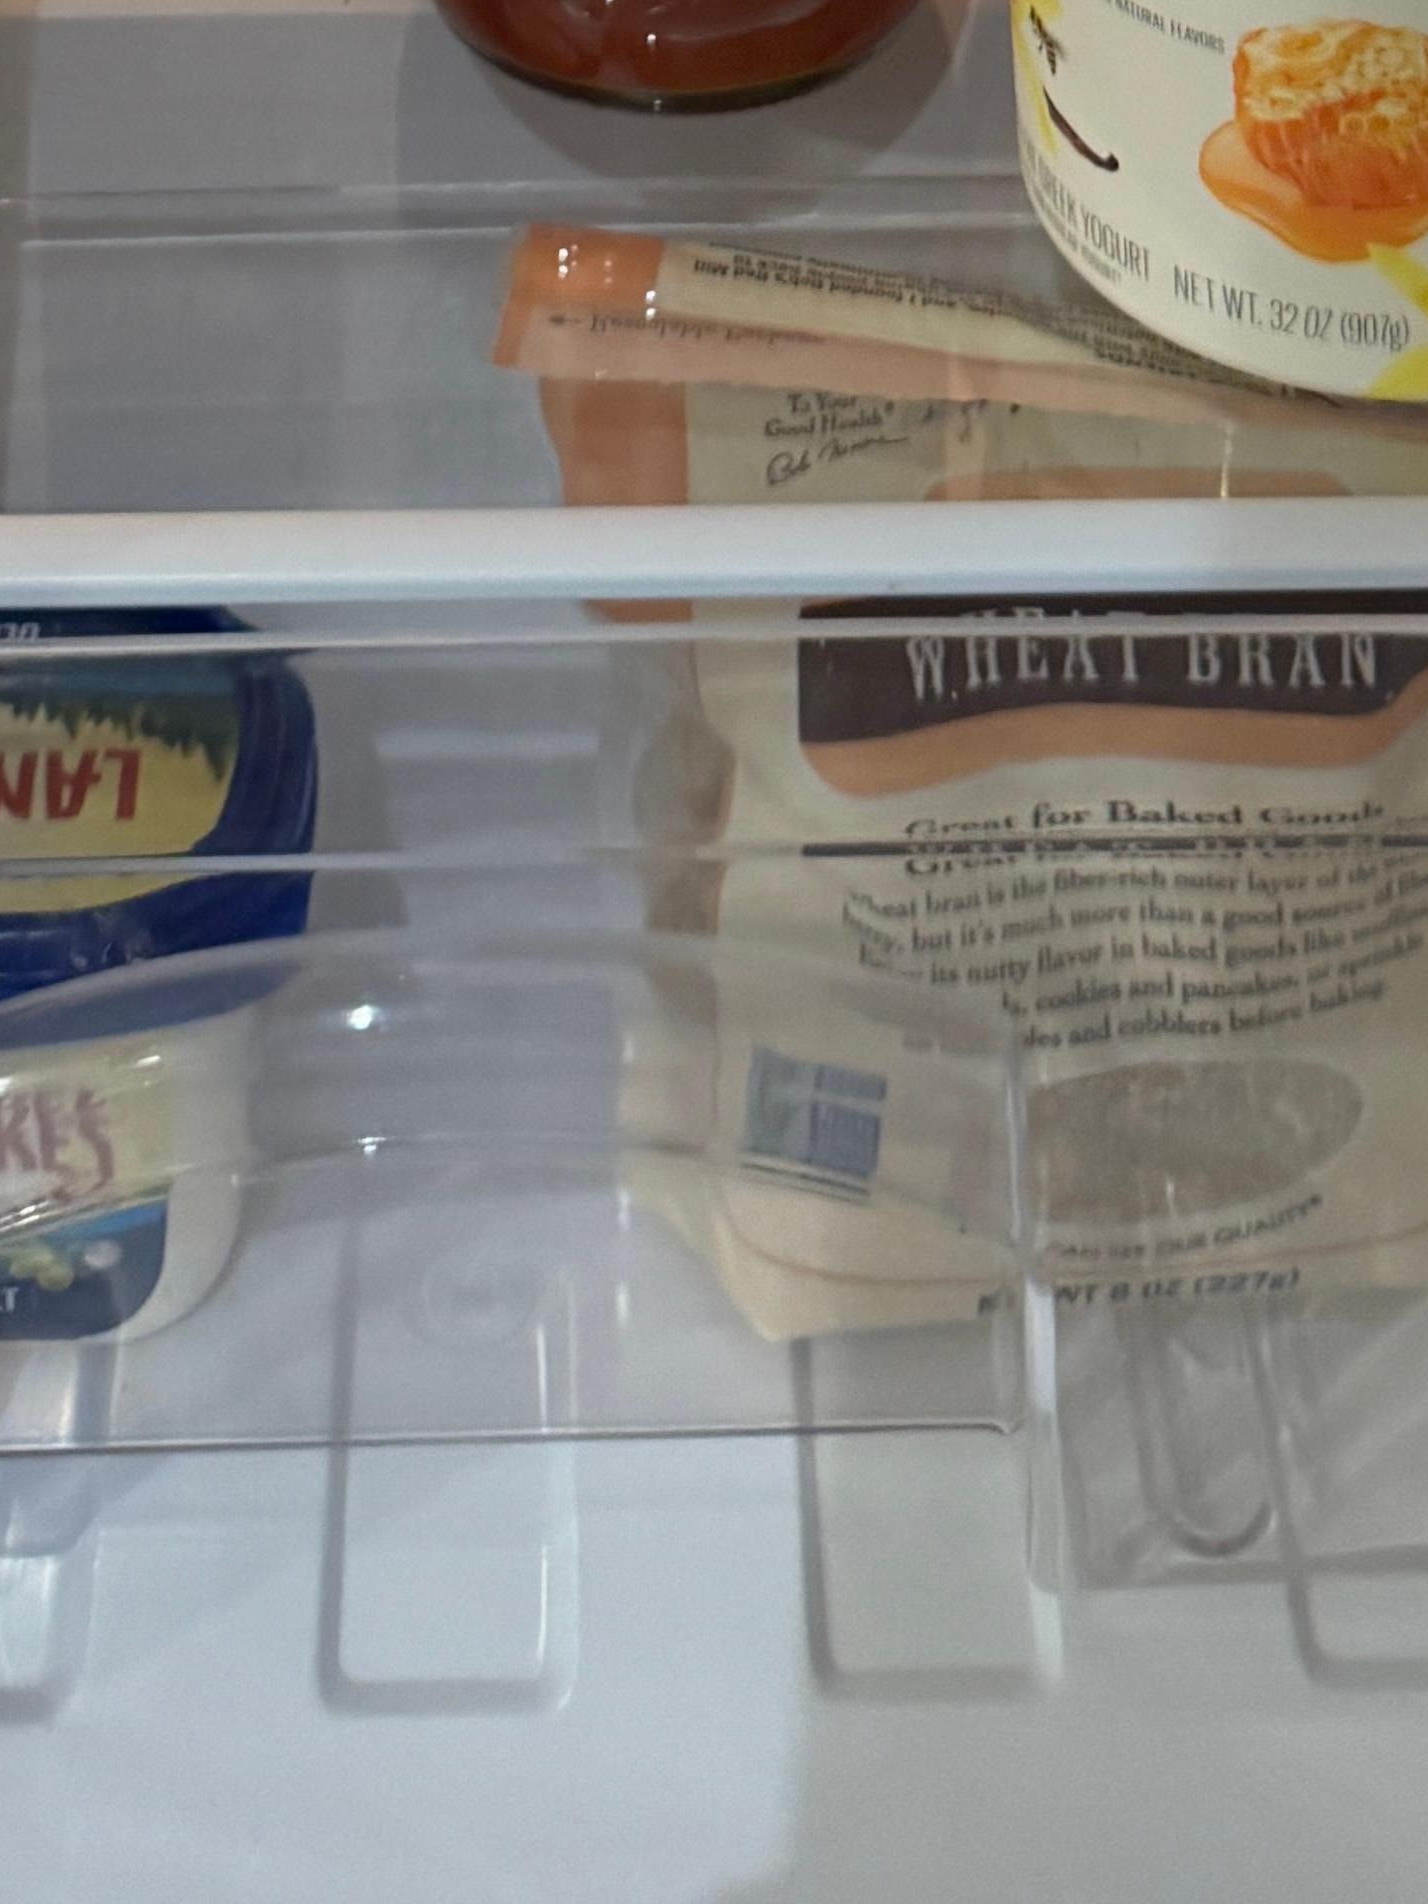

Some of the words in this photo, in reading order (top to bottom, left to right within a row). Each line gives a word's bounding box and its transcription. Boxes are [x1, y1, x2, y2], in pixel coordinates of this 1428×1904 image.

[1171, 18, 1225, 54] FLAVORS
[1079, 208, 1150, 282] YOGURT
[1173, 265, 1215, 312] NET
[1223, 285, 1263, 326] WT.
[1270, 299, 1297, 336] 32
[1304, 308, 1331, 338] OZ
[1341, 312, 1409, 350] (907g)
[904, 634, 1141, 702] WHEAT
[1187, 631, 1378, 686] BRAN
[1032, 806, 1091, 830] for
[1107, 799, 1244, 827] Baked
